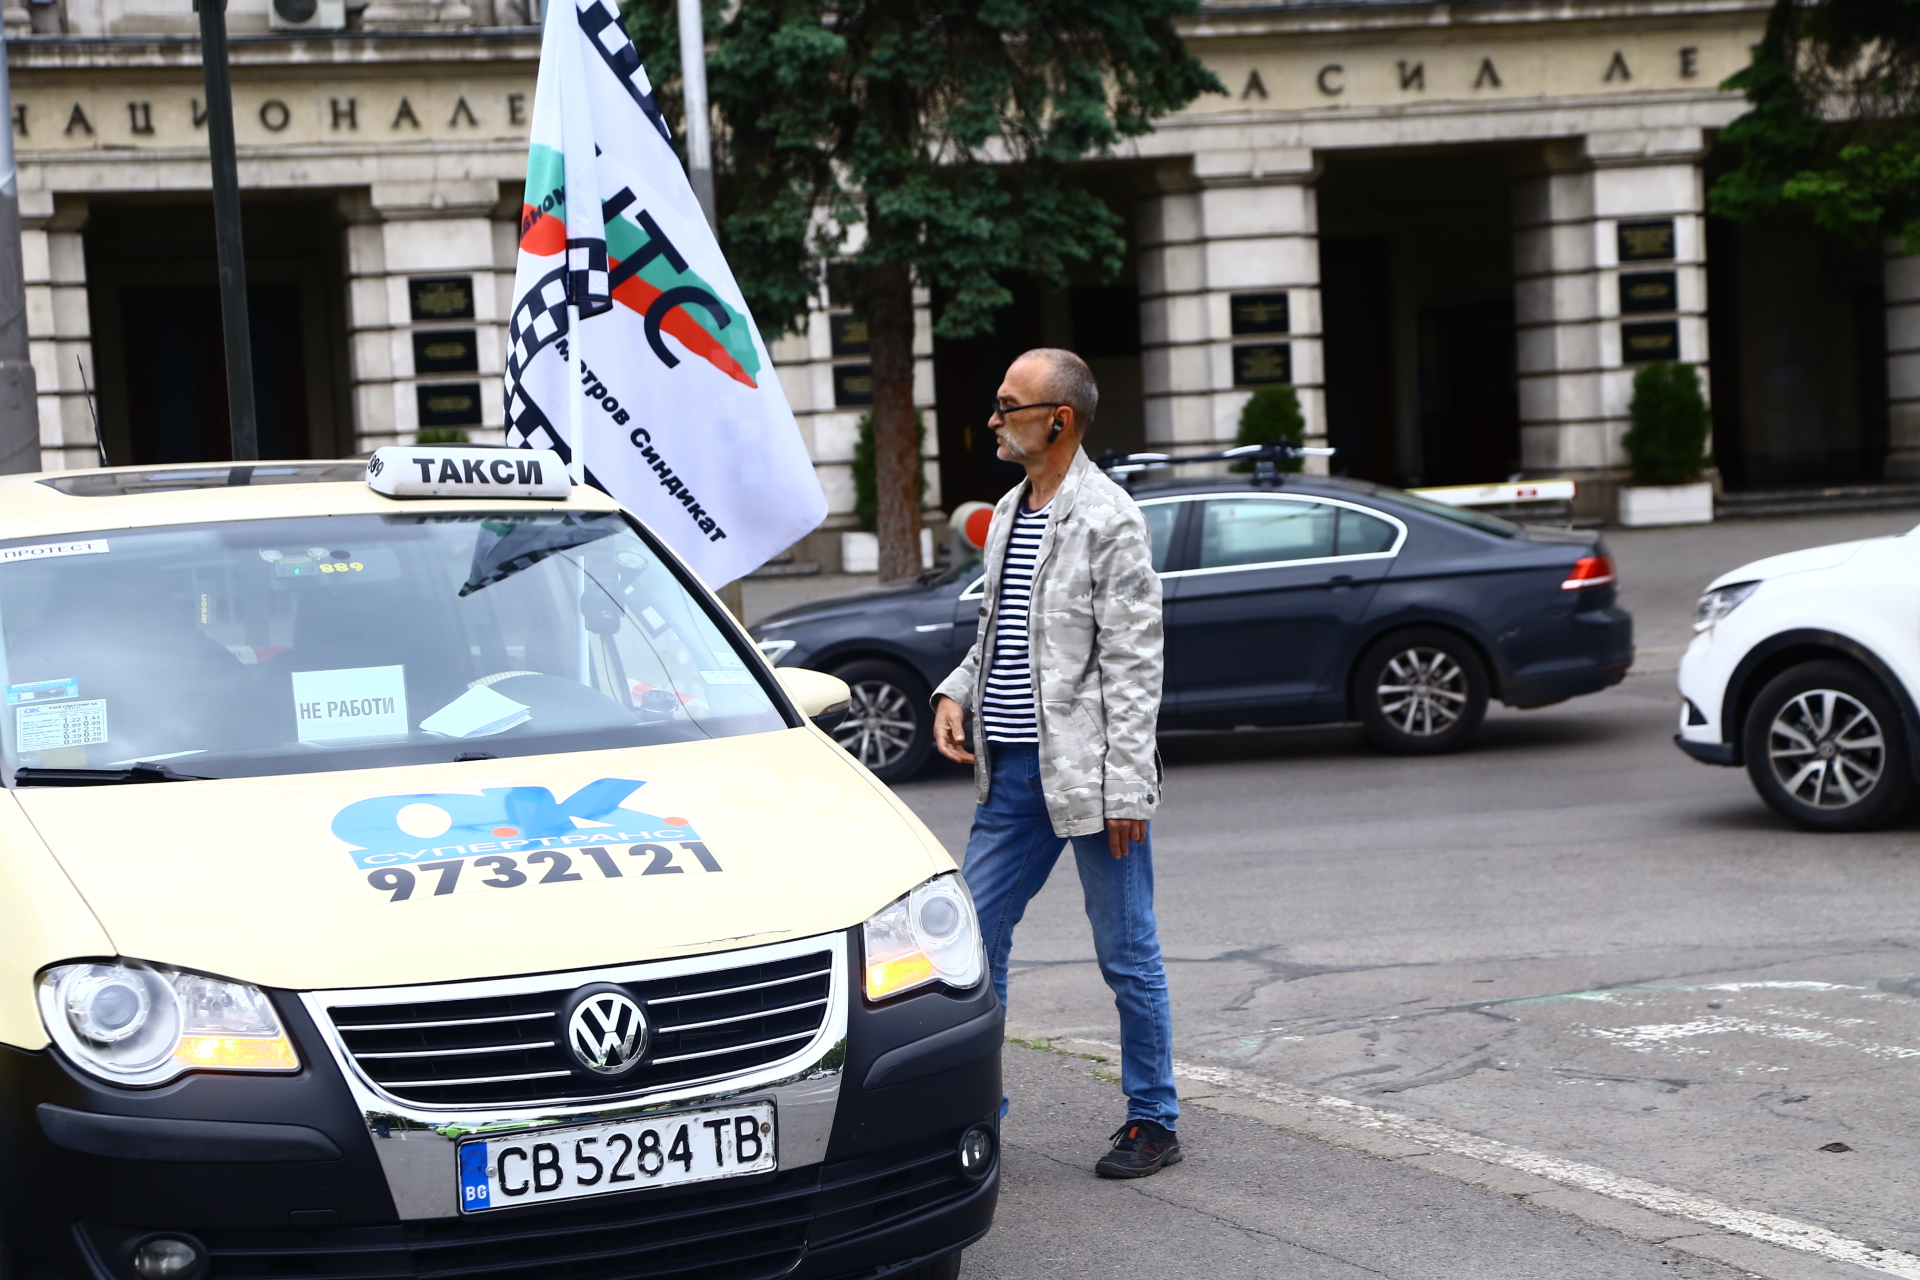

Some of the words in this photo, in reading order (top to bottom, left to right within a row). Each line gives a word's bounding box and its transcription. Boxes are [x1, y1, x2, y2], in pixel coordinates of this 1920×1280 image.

[1242, 57, 1502, 100] АСИЛ
[1602, 47, 1698, 82] ЛЕ
[12, 92, 527, 136] НАЦИОНАЛЕ
[600, 186, 731, 369] ТС
[412, 458, 543, 485] ТАКСИ
[630, 428, 727, 542] Синдикат
[4, 543, 95, 558] ПРОТЕСТ
[319, 562, 364, 573] 889
[300, 702, 322, 719] НЕ
[327, 697, 395, 718] РАБОТИ
[363, 829, 687, 865] СУПЕРТРАНС
[367, 841, 724, 902] 9732121
[568, 992, 649, 1075] VW
[497, 1143, 563, 1196] CB
[574, 1124, 693, 1186] 5284
[703, 1115, 763, 1166] TB
[465, 1185, 487, 1200] BG
